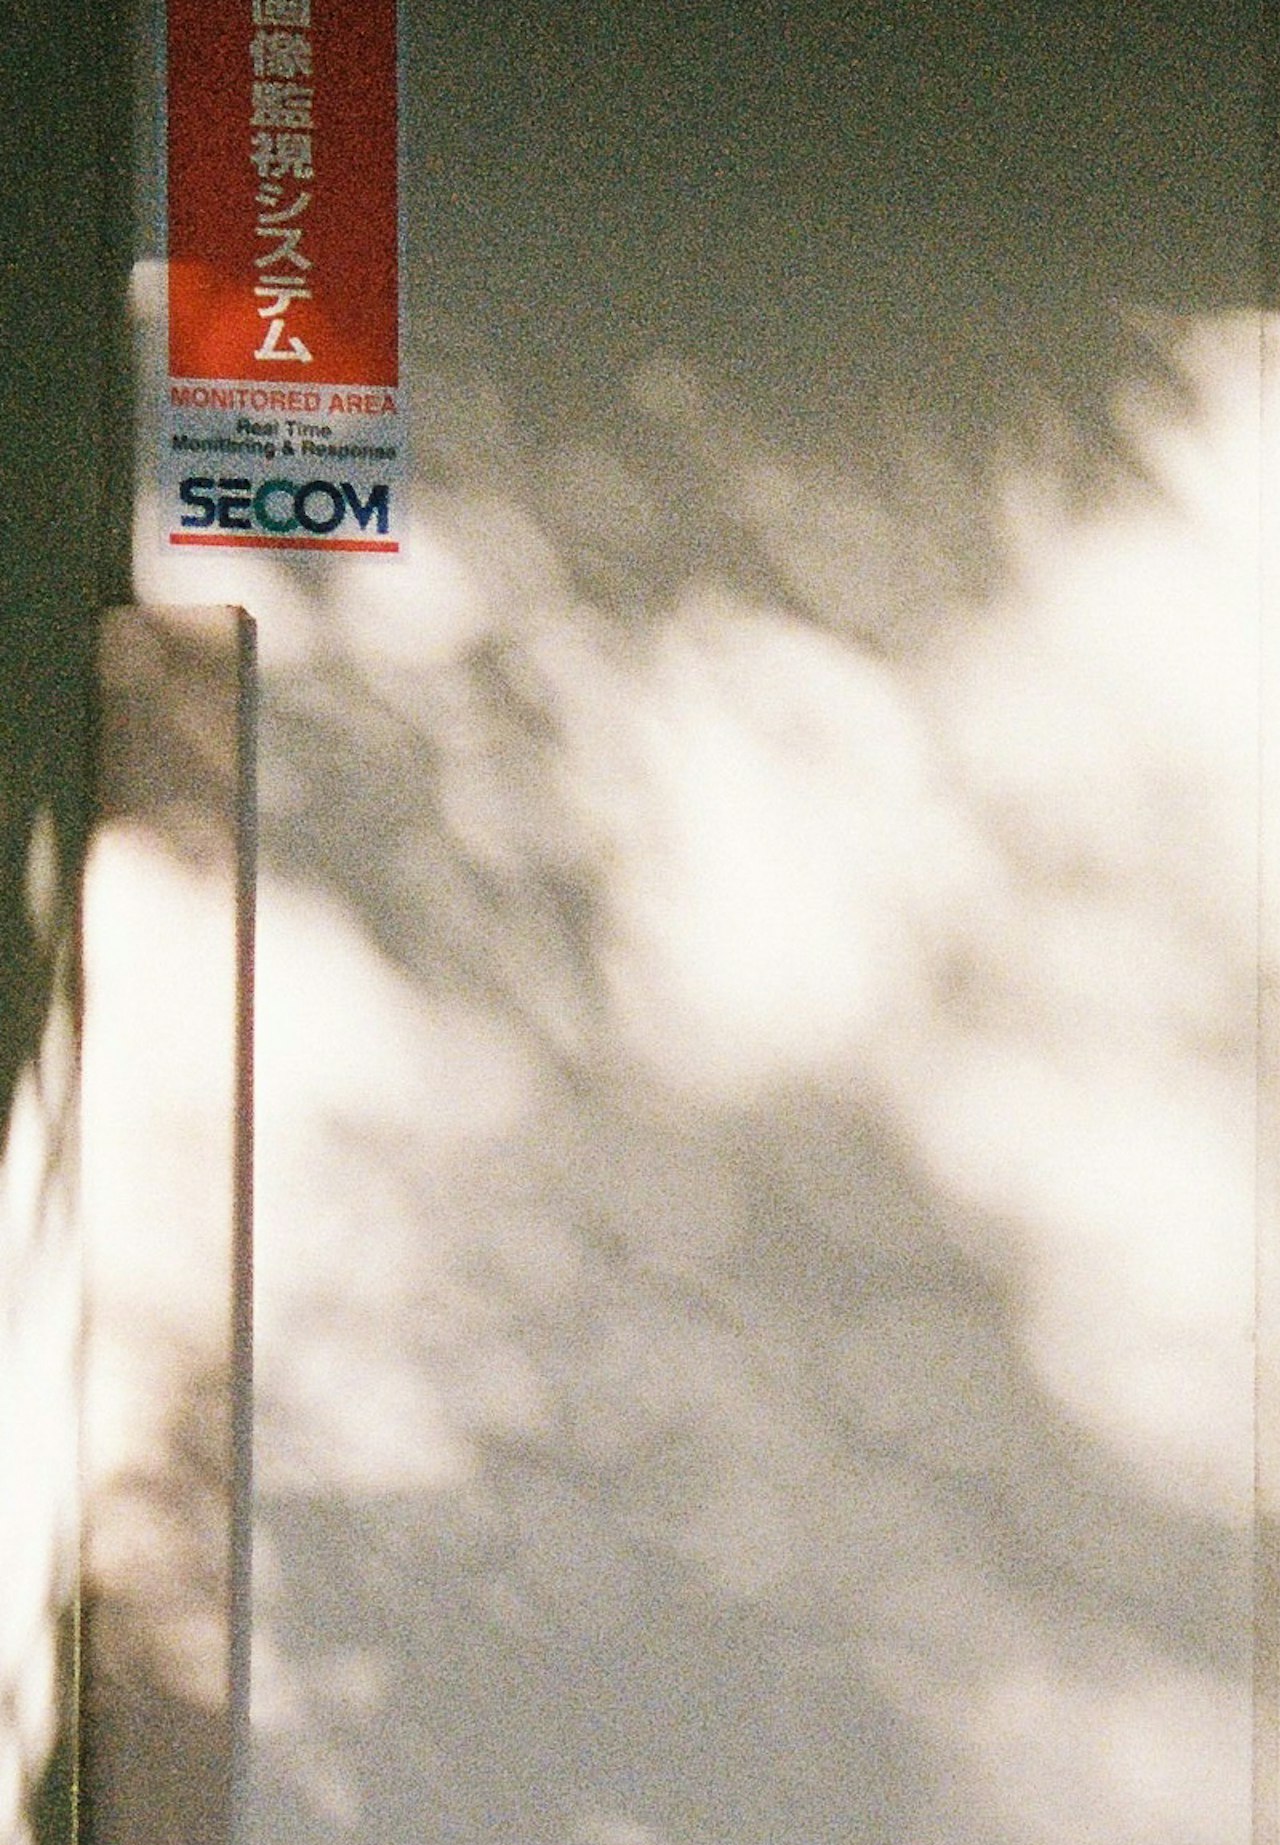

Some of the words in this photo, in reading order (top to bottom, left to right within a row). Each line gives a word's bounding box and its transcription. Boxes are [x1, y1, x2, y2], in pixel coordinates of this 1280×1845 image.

[171, 386, 321, 412] MONITORED
[328, 393, 397, 415] AREA
[236, 418, 280, 436] Real
[285, 420, 333, 437] Time
[302, 440, 398, 461] Response
[180, 478, 390, 535] SECOM
